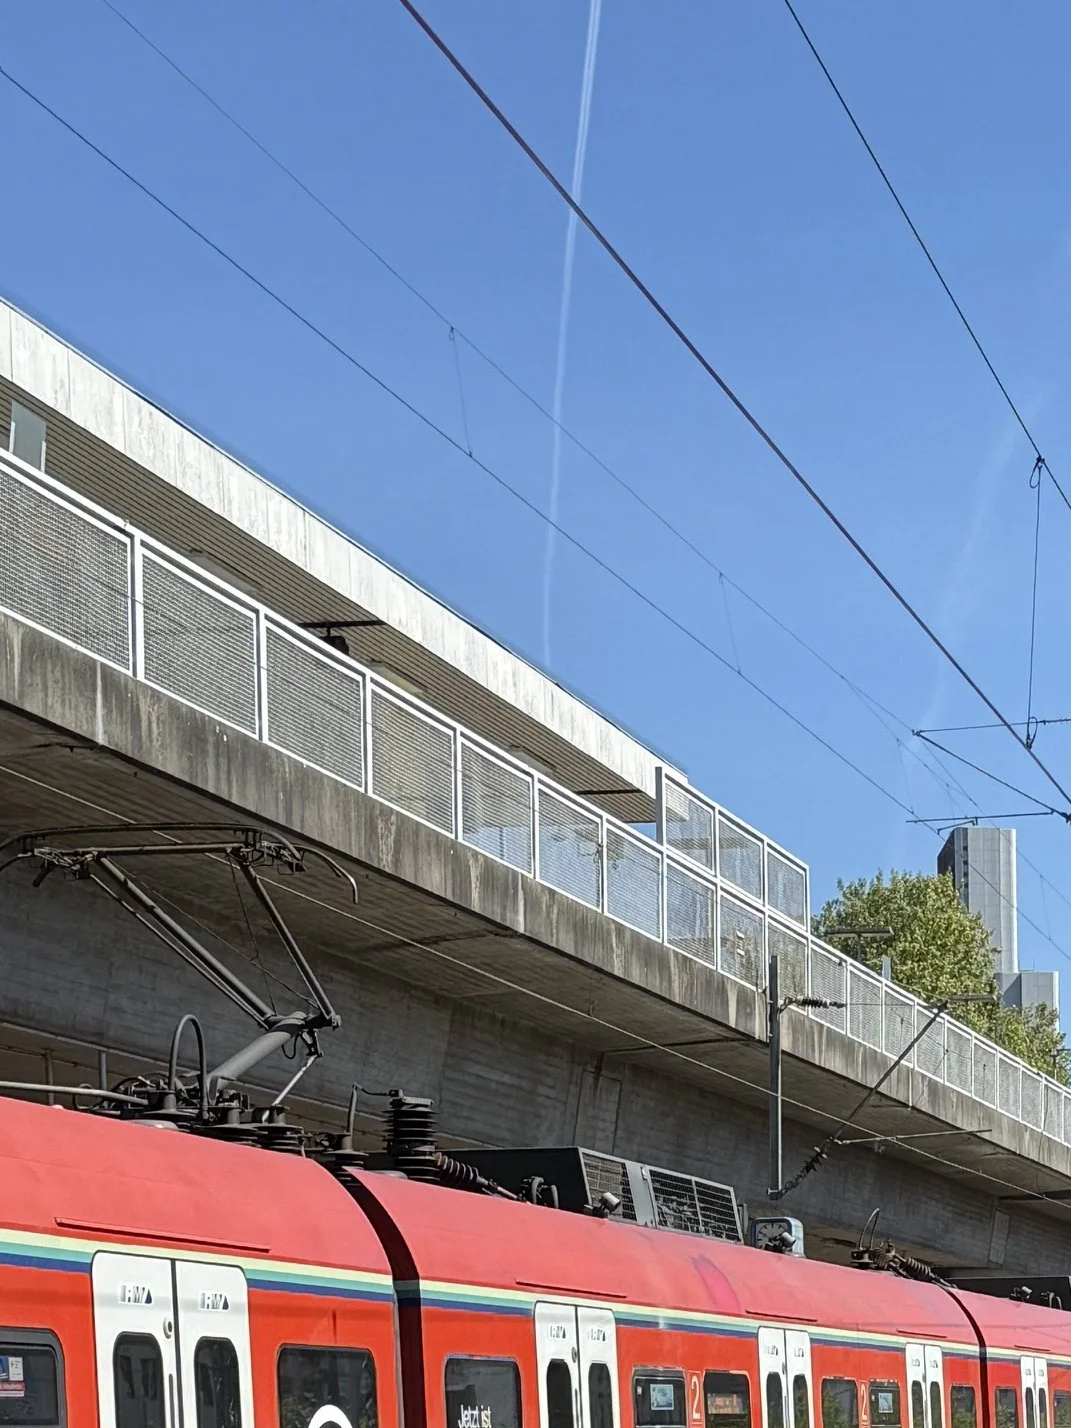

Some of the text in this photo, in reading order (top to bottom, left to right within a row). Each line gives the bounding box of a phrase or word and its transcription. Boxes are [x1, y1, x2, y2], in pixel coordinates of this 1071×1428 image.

[691, 1375, 701, 1420] 2
[458, 1404, 492, 1428] Jetzt ist
